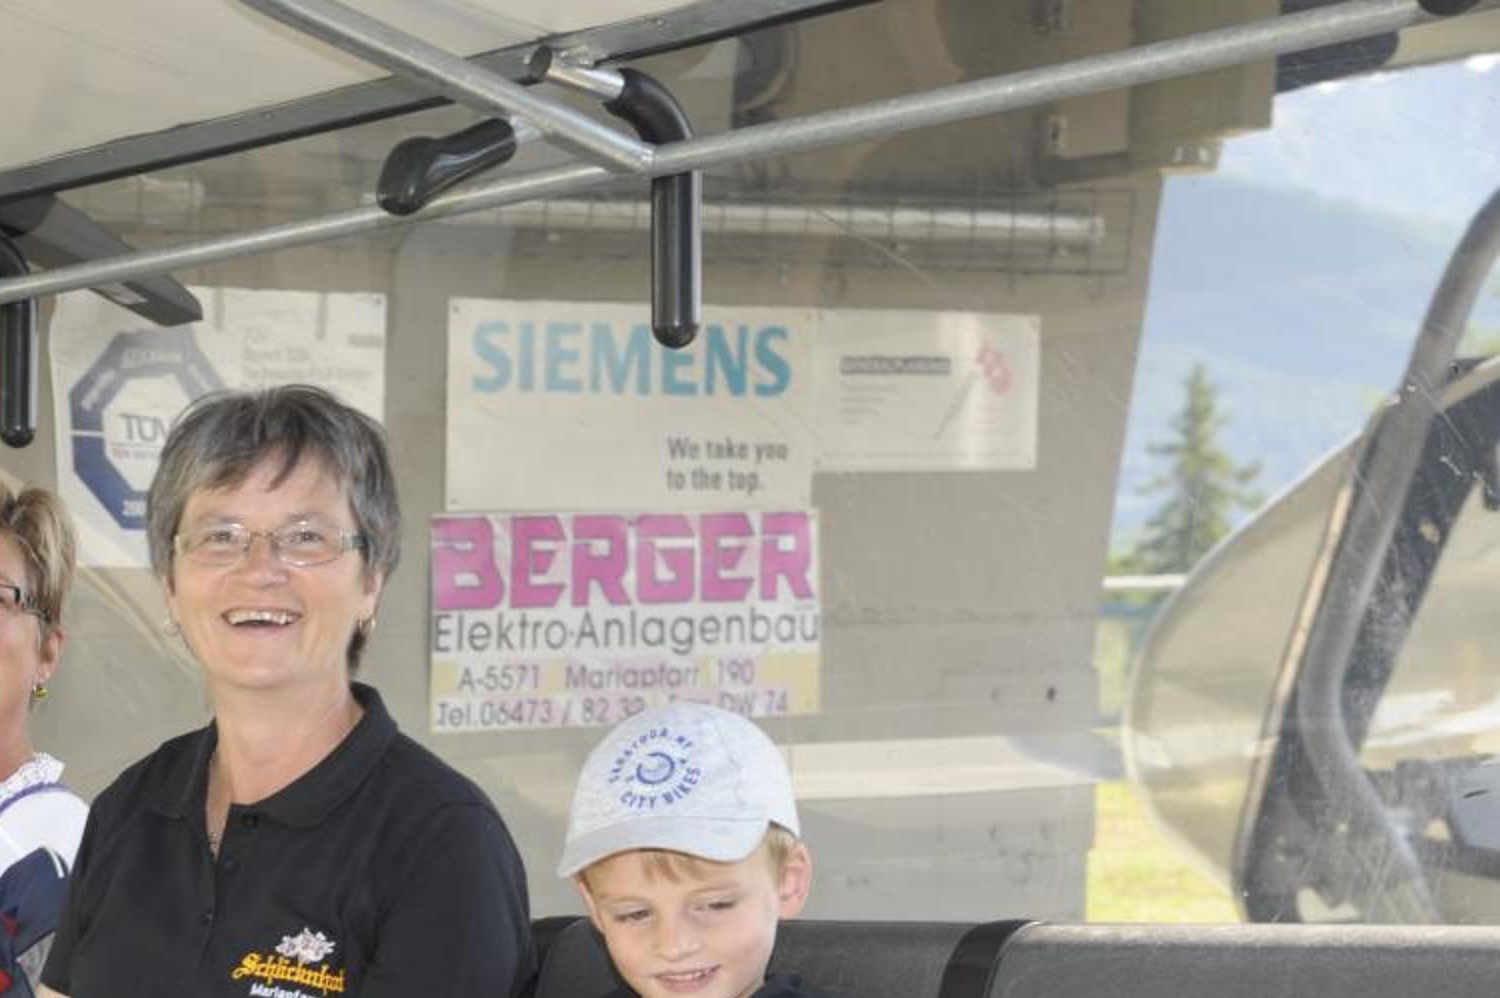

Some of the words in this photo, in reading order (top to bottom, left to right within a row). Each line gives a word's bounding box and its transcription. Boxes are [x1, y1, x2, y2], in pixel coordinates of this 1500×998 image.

[471, 320, 791, 397] SIEMENS
[667, 438, 699, 460] We
[706, 437, 748, 460] take
[755, 442, 788, 465] you
[666, 471, 685, 490] to
[691, 469, 721, 491] the
[432, 511, 814, 611] BERGER
[459, 663, 541, 692] A-5571
[717, 657, 755, 686] 190
